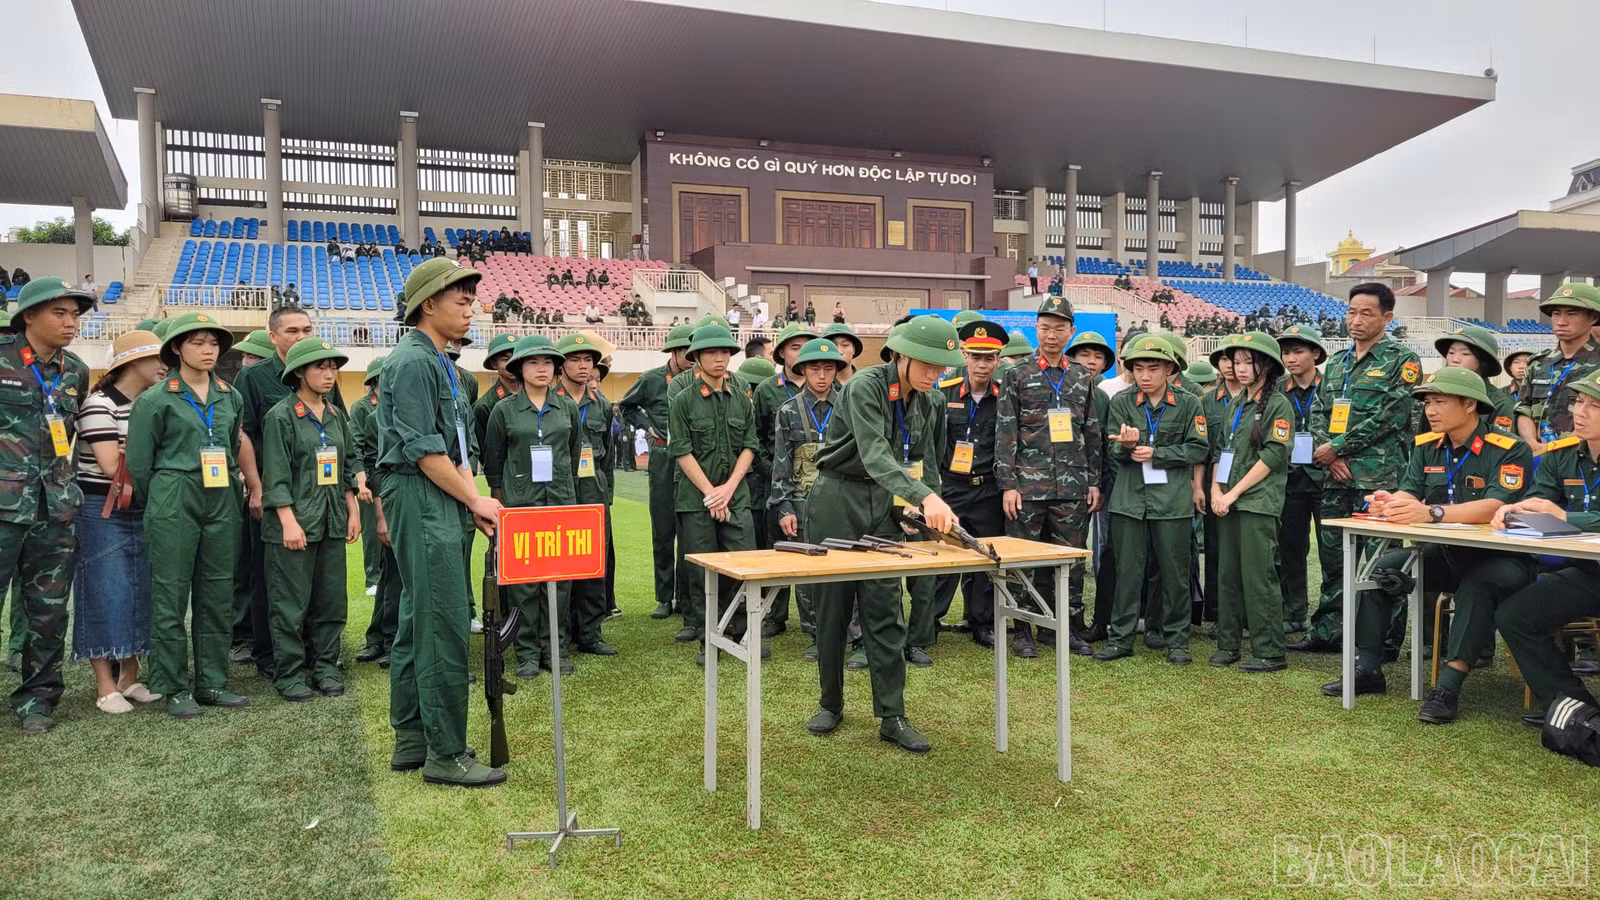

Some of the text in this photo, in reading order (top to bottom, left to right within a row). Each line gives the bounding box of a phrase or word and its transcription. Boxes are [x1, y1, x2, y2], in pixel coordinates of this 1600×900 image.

[669, 152, 732, 168] KHÔNG
[735, 156, 760, 170] CÓ
[763, 157, 780, 172] GÌ
[784, 160, 819, 174] QUÝ
[822, 164, 855, 177] HƠN
[858, 165, 892, 182] ĐỘC
[895, 168, 926, 184] LẬP
[927, 171, 949, 187] TỰ
[513, 524, 592, 565] VỊ TRÍ THI
